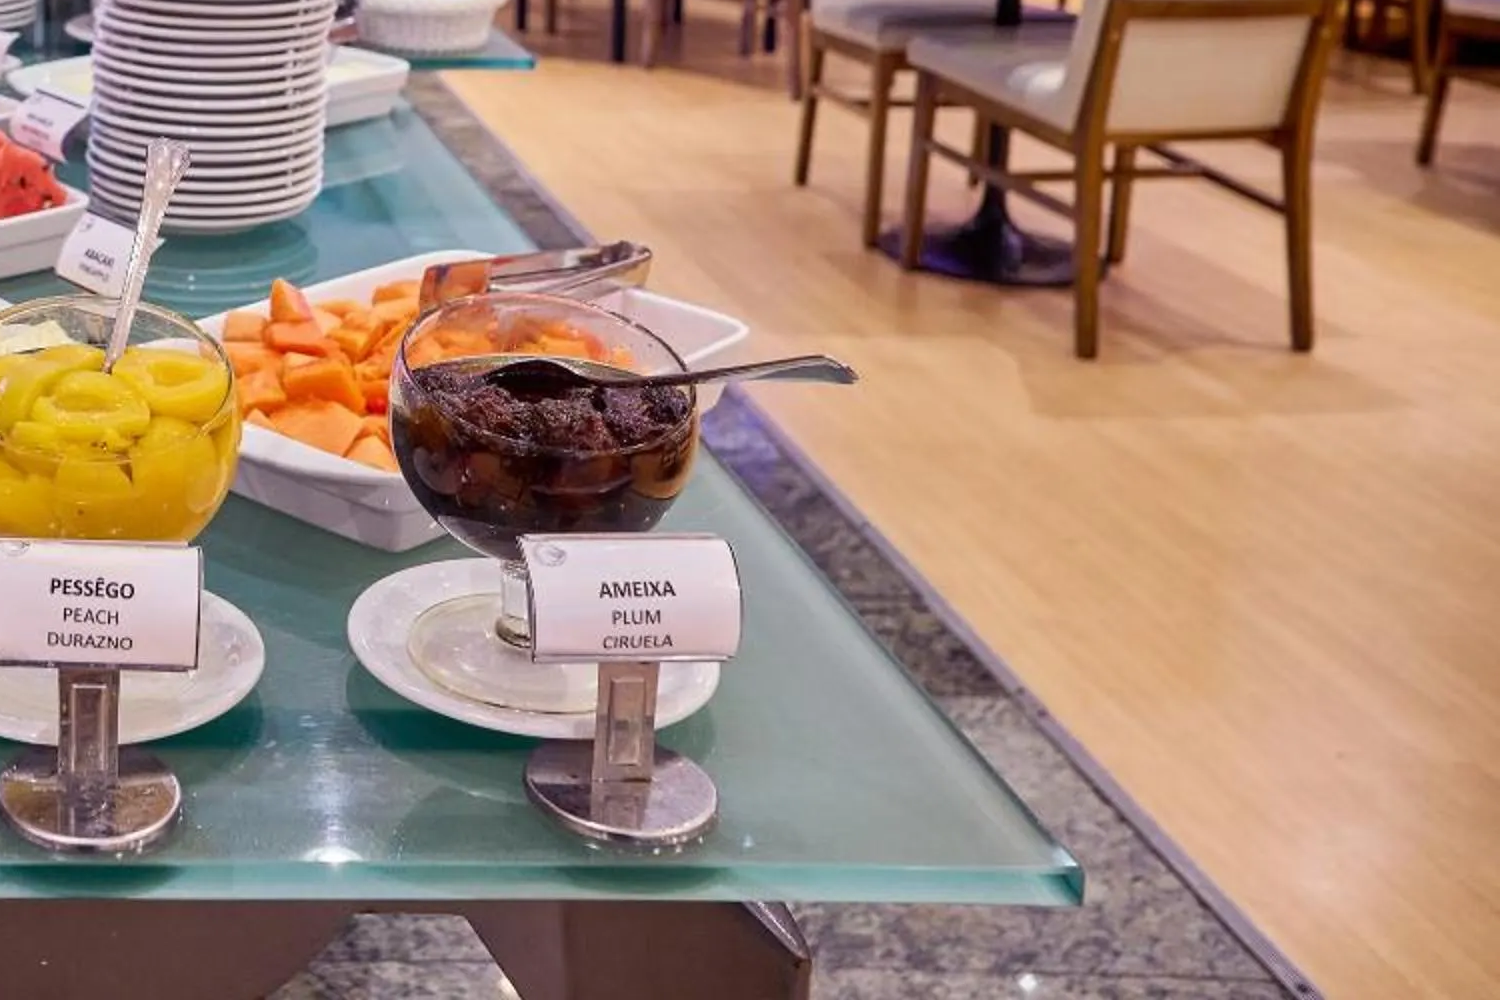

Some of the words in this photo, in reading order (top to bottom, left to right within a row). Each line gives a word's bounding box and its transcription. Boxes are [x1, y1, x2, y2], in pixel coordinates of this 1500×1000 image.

[49, 576, 136, 600] PESSÊGO
[598, 579, 677, 599] AMEIXA
[62, 606, 120, 626] PEACH
[611, 609, 662, 626] PLUM
[47, 631, 134, 651] DURAZNO
[602, 634, 674, 651] CIRUELA
